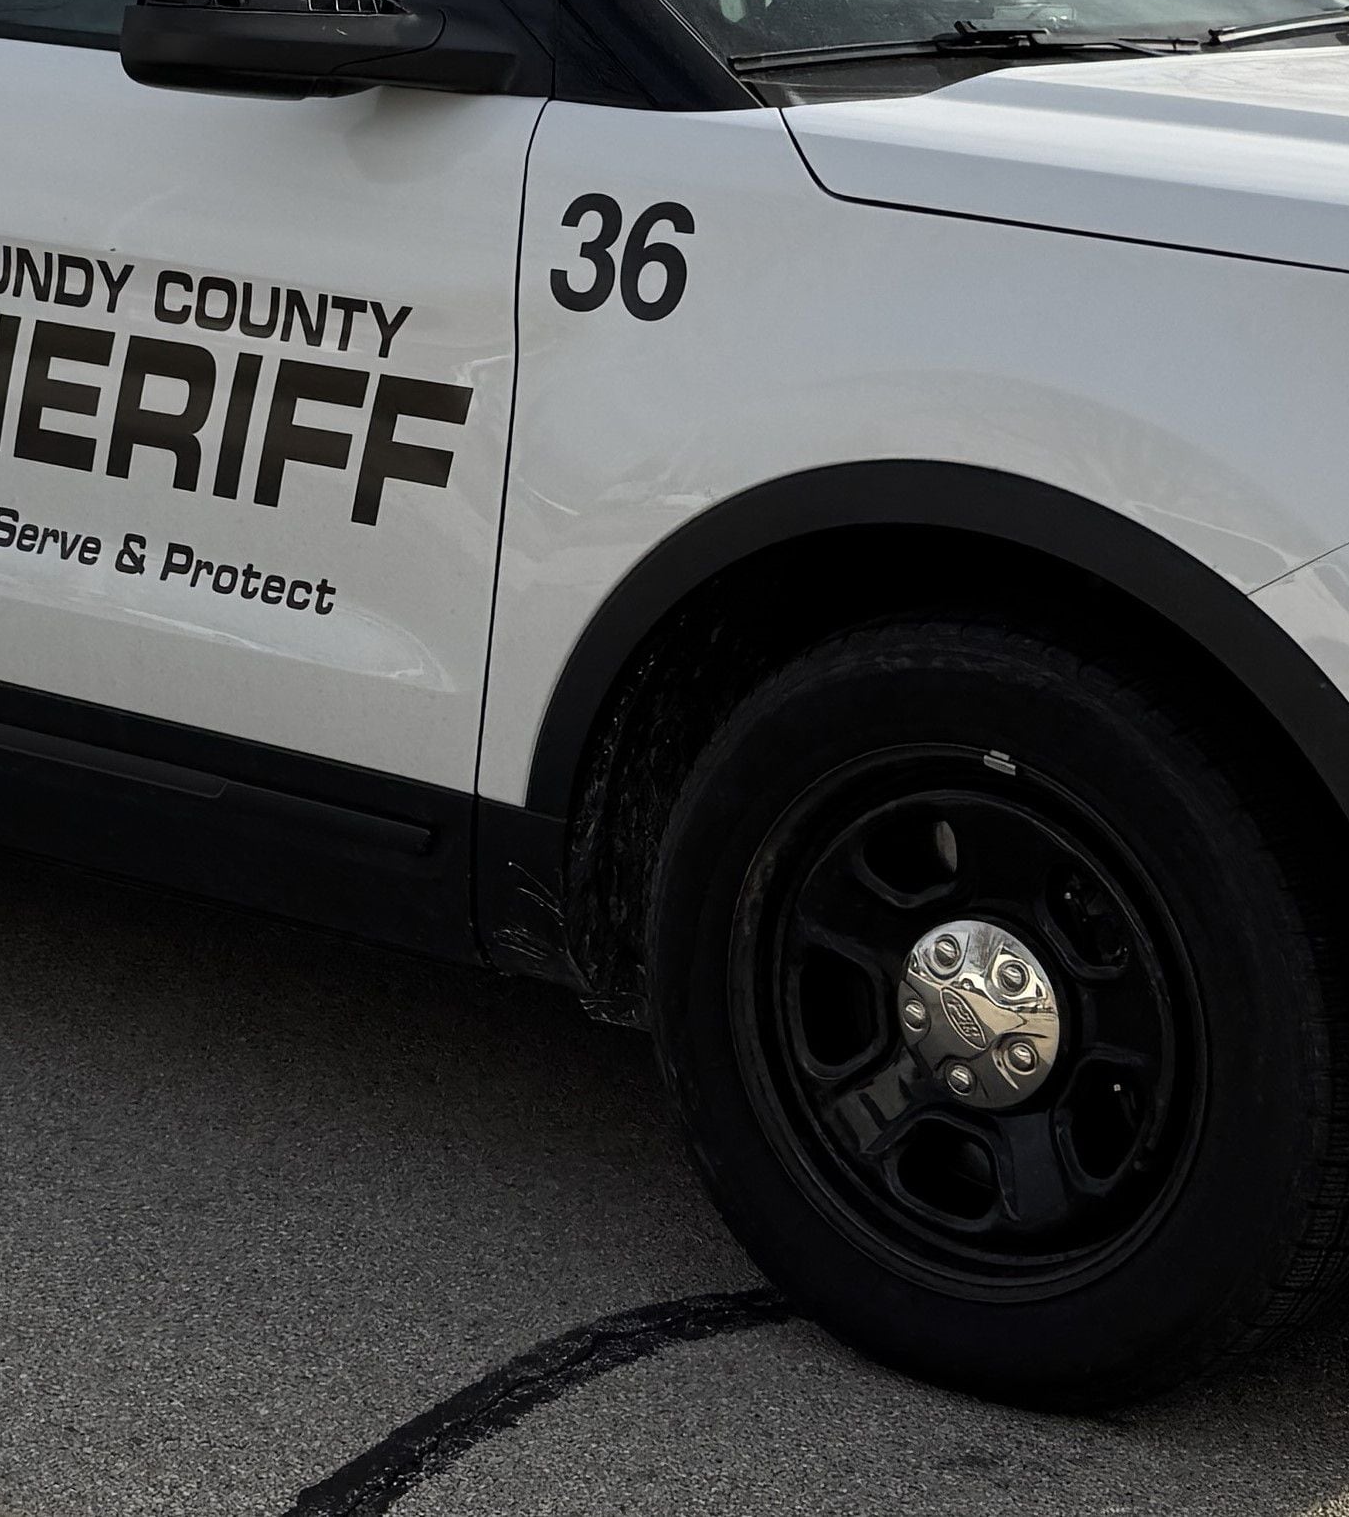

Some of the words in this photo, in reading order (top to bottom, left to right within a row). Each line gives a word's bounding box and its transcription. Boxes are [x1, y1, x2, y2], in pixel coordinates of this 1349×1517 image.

[549, 192, 695, 322] 36
[154, 269, 414, 359] COUNTY
[114, 532, 147, 575] &
[159, 542, 337, 616] Protect
